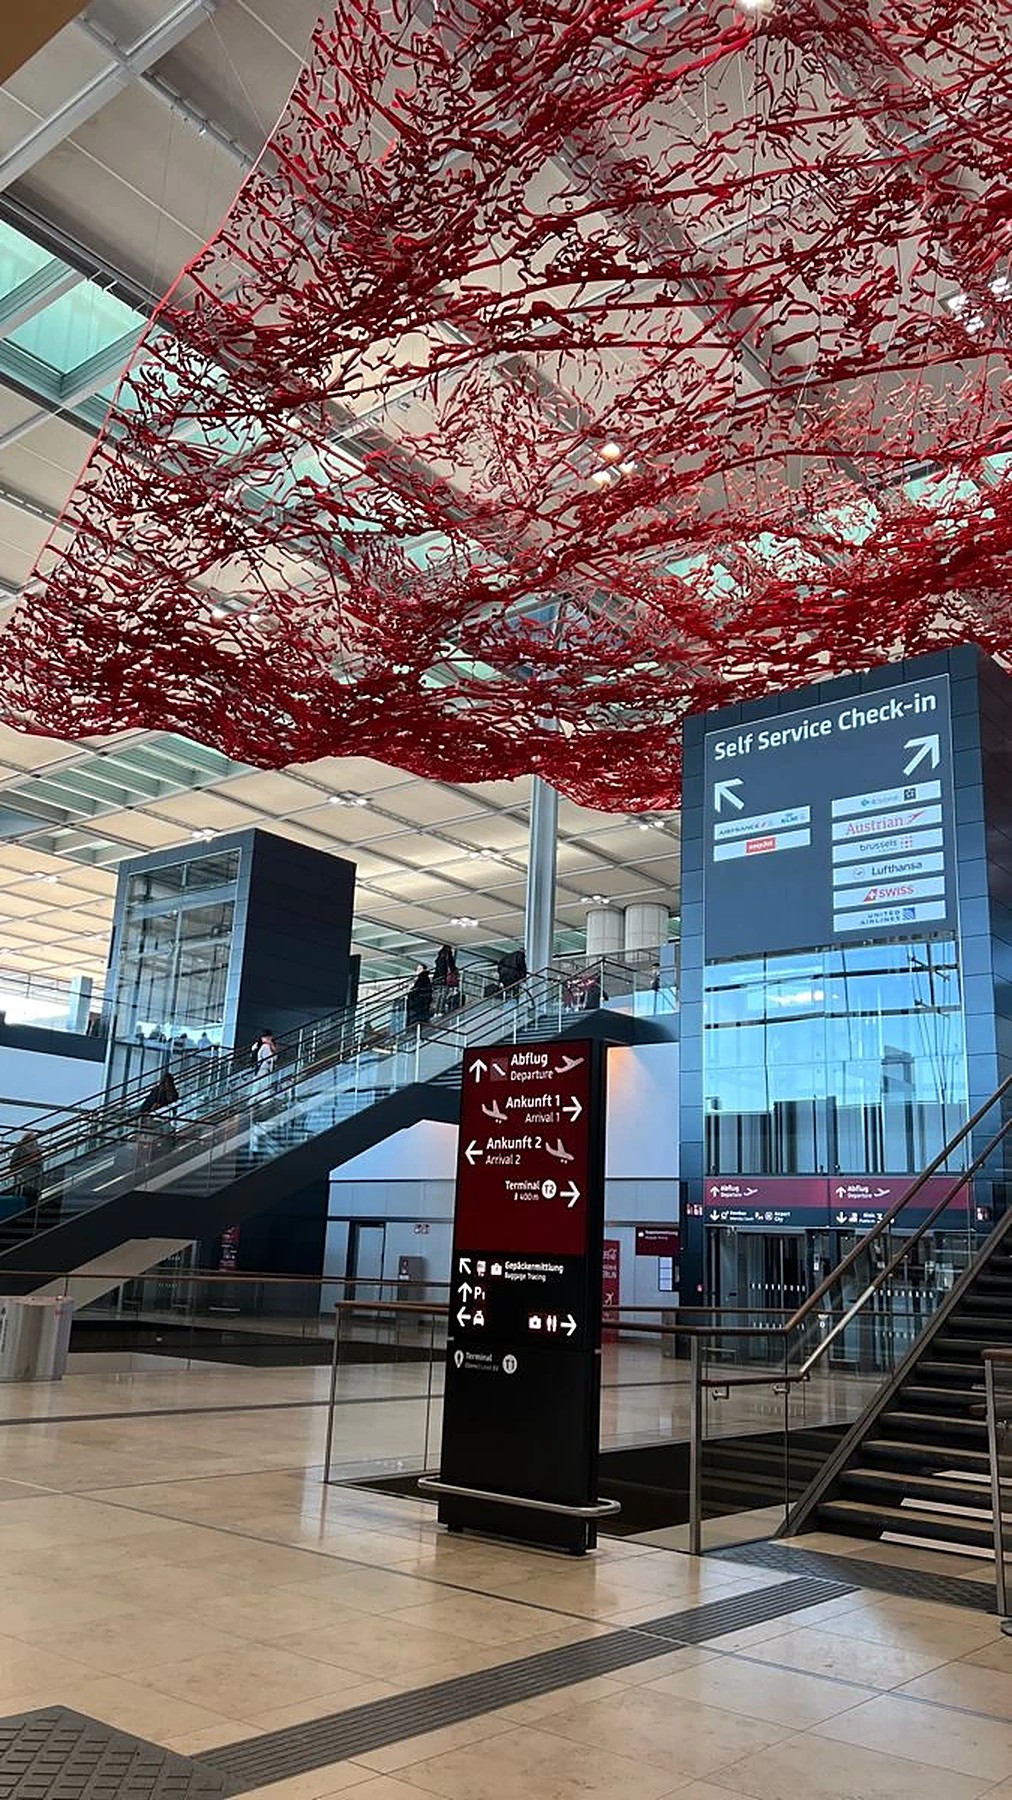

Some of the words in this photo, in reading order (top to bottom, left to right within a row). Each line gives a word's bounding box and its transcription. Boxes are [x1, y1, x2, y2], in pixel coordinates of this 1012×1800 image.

[714, 734, 753, 761] Self
[757, 719, 832, 751] Service
[838, 692, 937, 731] Check-in
[846, 816, 904, 836] Austrian
[859, 839, 898, 852] brussels
[871, 861, 923, 877] Lufthansa
[867, 909, 901, 919] UNITED
[860, 916, 901, 926] AIRLINES
[510, 1052, 548, 1067] Abflug
[510, 1069, 553, 1083] Departure
[505, 1094, 553, 1109] Ankunft
[555, 1094, 560, 1107] 1
[524, 1112, 554, 1124] Arrival
[556, 1112, 560, 1122] 1
[486, 1135, 533, 1150] Ankunft
[534, 1136, 542, 1149] 2
[485, 1154, 514, 1165] Arrival
[514, 1154, 521, 1165] 2
[504, 1180, 540, 1191] Terminal
[544, 1184, 555, 1195] T2
[720, 1184, 740, 1194] Abflug
[846, 1184, 869, 1194] Abflug
[474, 1286, 486, 1300] P1
[465, 1351, 493, 1363] Terminal
